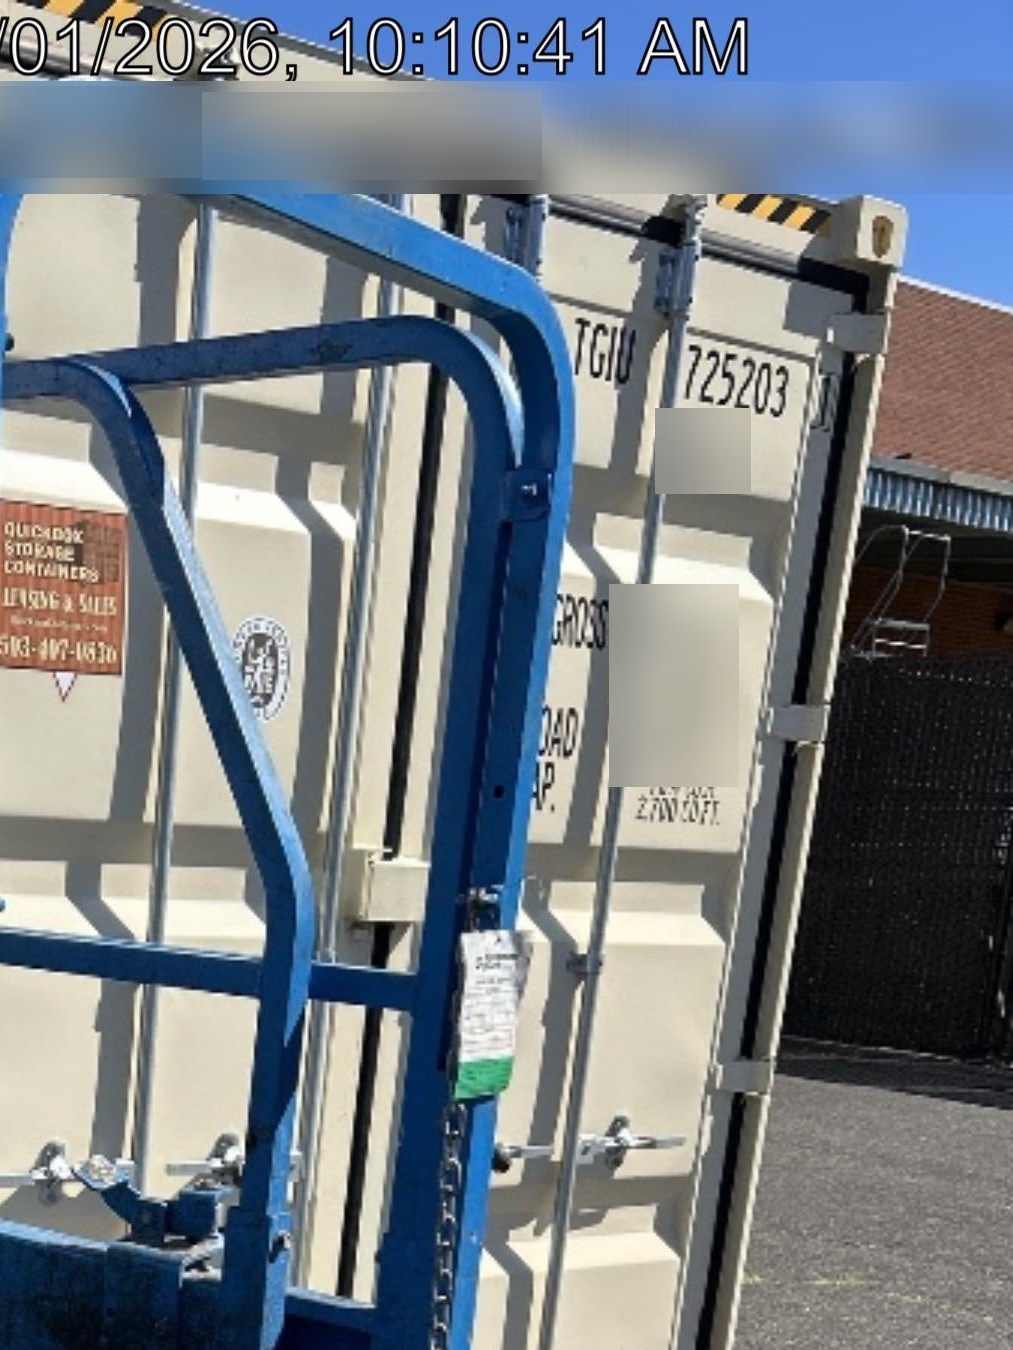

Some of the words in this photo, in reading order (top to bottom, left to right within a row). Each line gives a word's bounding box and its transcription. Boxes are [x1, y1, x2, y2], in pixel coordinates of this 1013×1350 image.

[574, 317, 636, 385] TGIU
[685, 344, 789, 418] 725203
[4, 560, 100, 583] CONTAINERS
